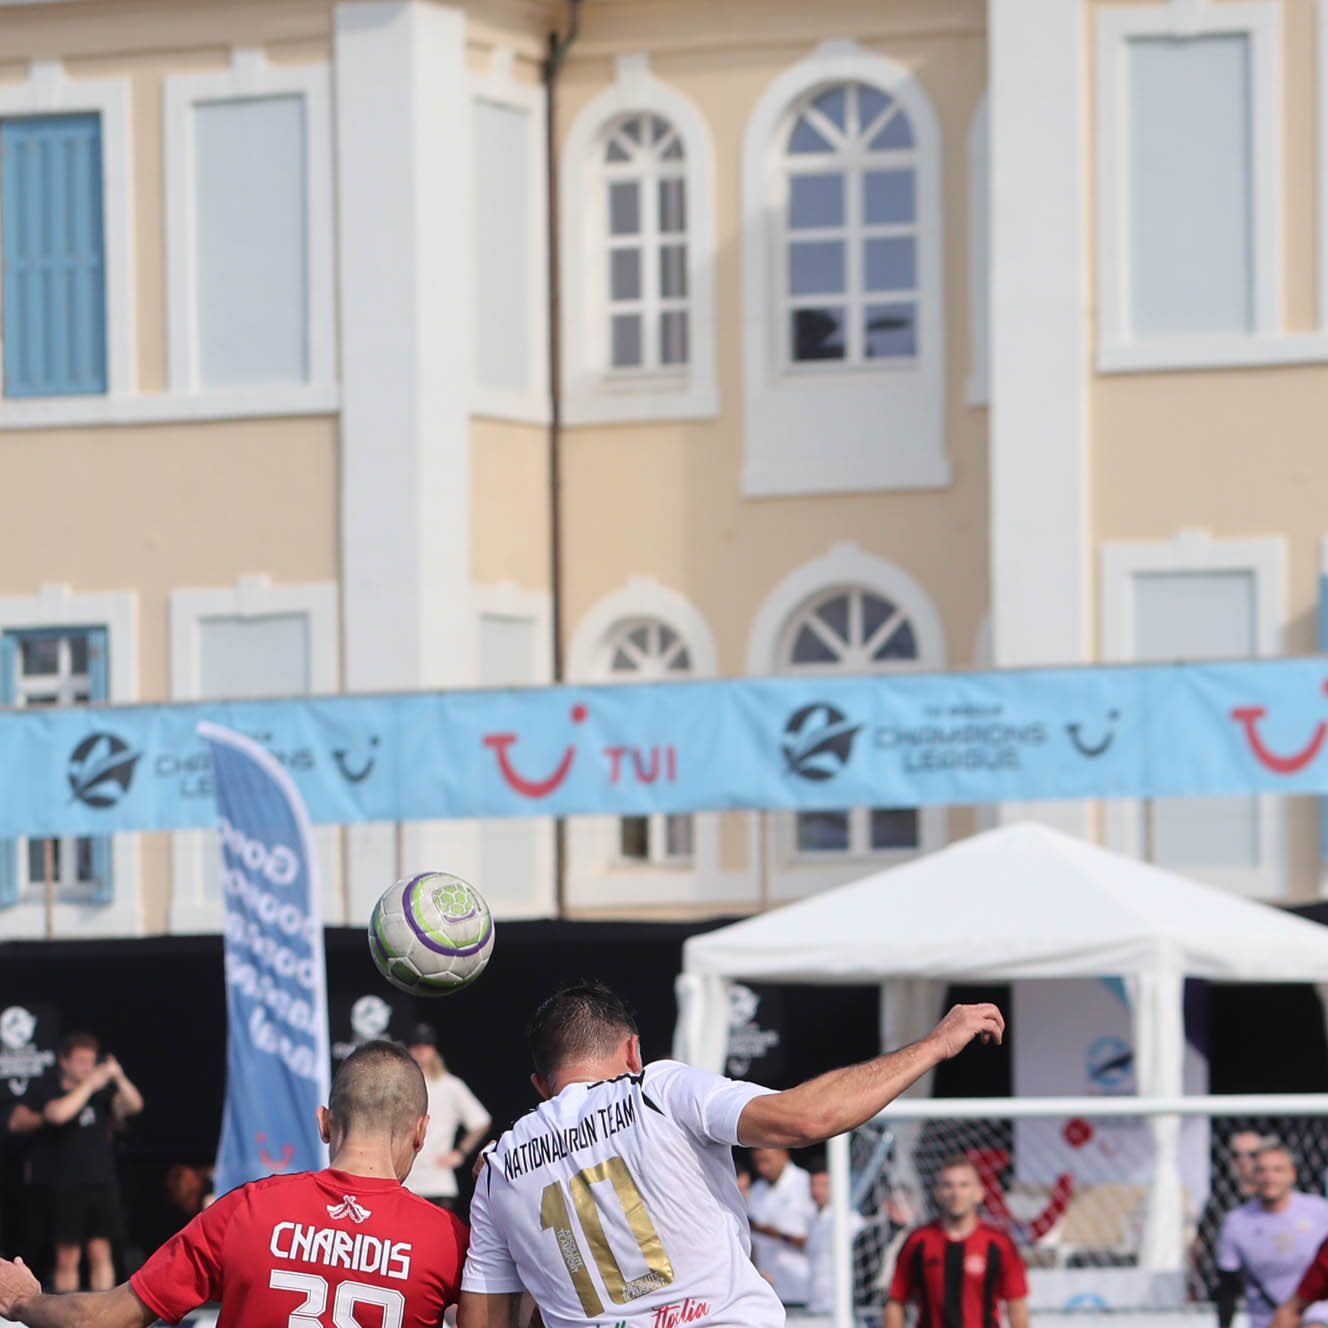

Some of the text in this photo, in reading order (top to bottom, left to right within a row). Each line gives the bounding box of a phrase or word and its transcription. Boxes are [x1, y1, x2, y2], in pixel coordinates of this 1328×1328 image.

[602, 747, 678, 785] TUI
[504, 1128, 569, 1182] NATIONAL
[597, 1094, 636, 1138] TEAM
[540, 1156, 674, 1318] 10
